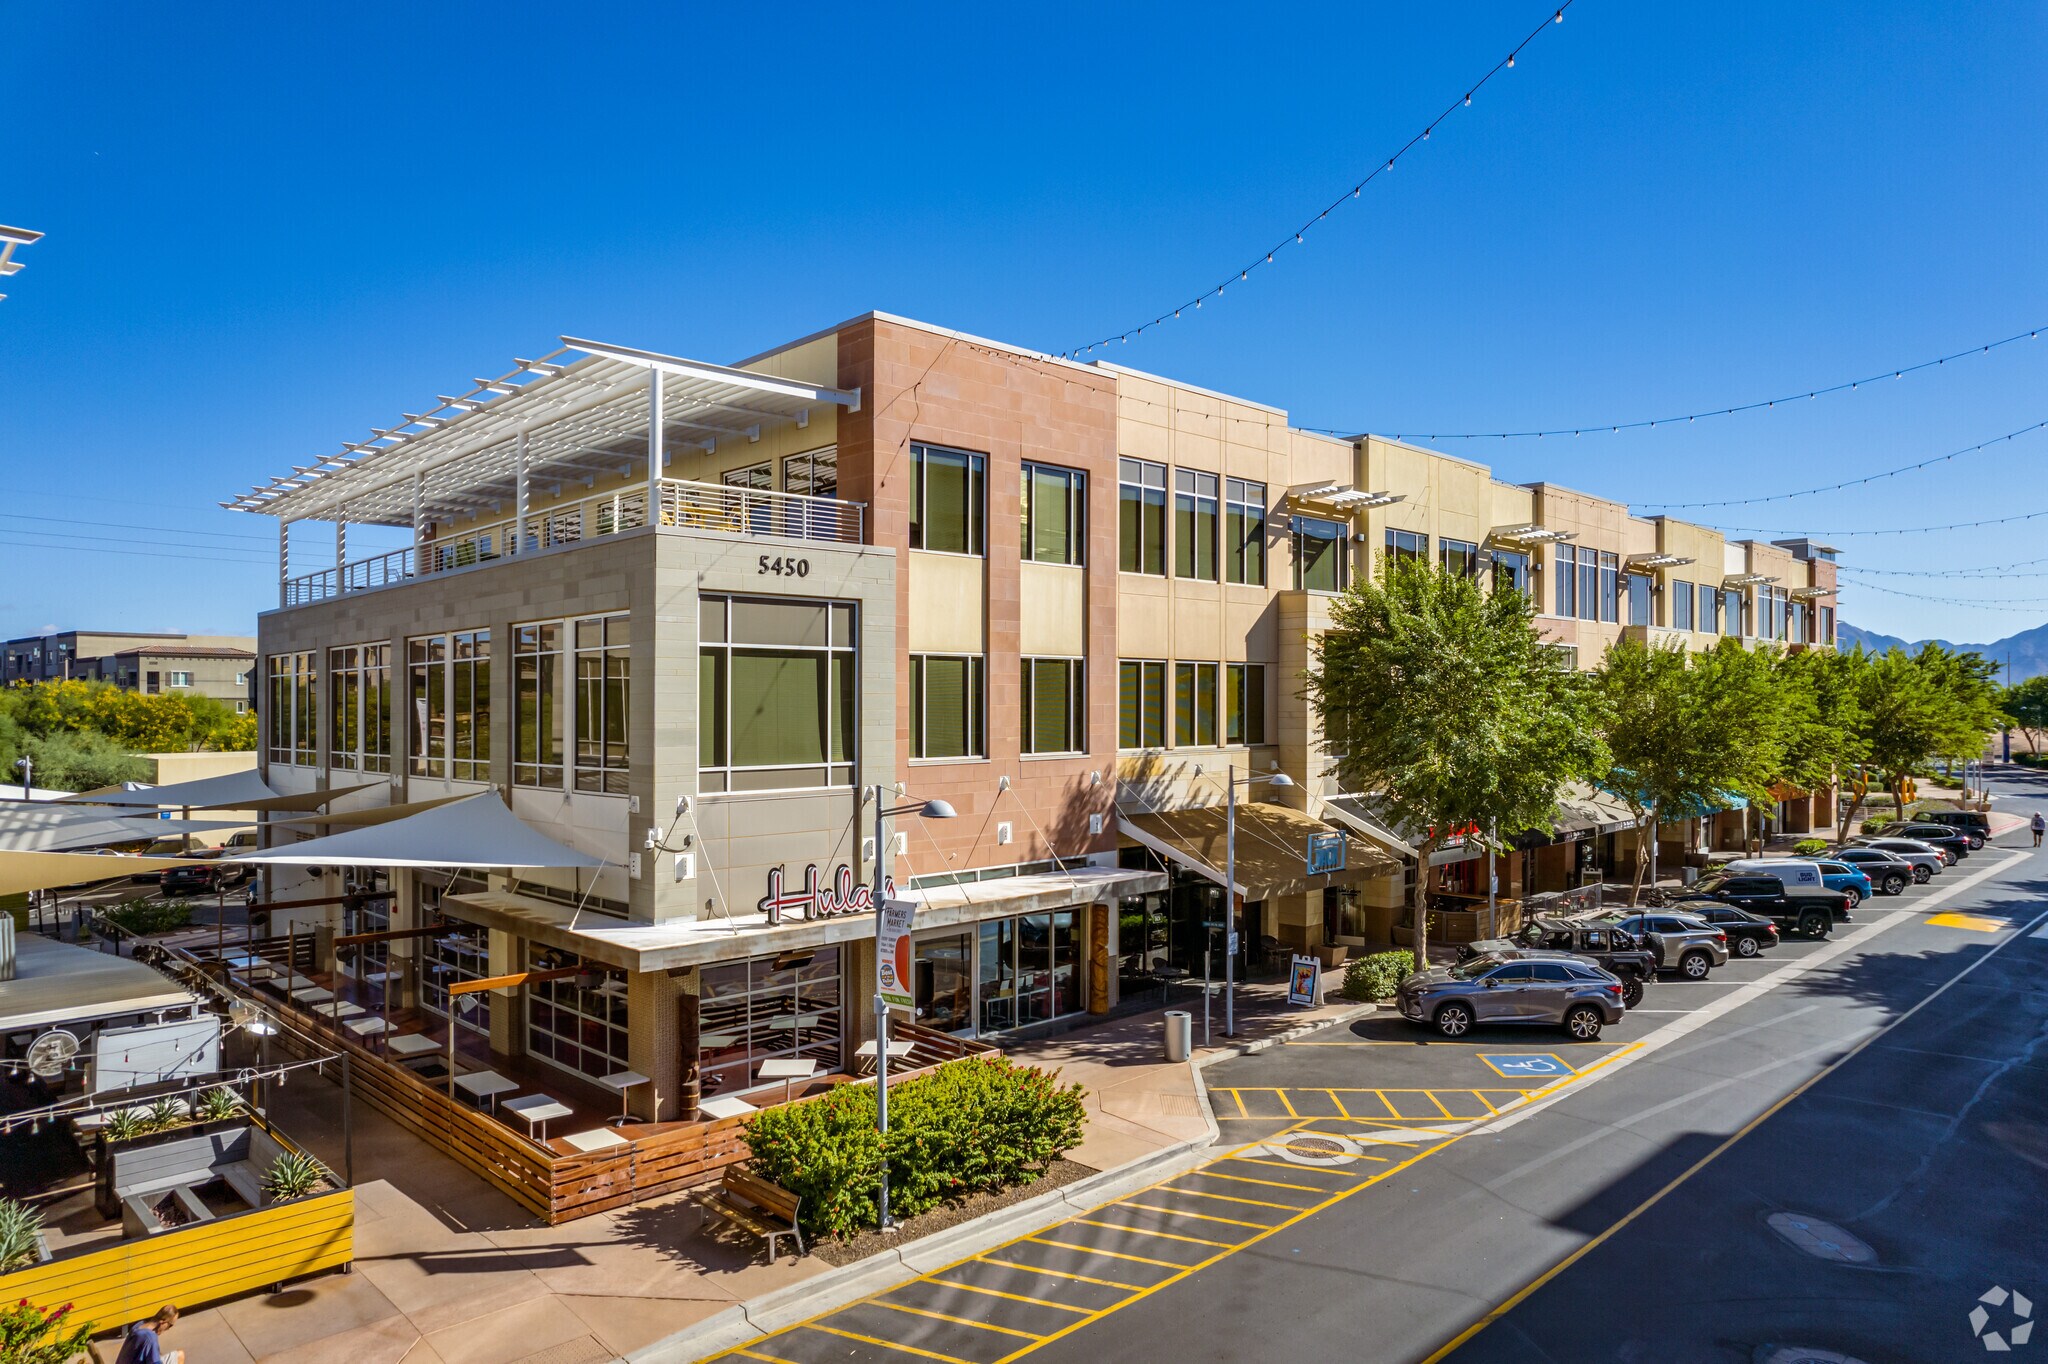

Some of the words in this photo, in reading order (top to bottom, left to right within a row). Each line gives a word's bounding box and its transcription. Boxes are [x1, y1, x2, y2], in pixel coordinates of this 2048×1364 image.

[758, 555, 809, 577] 5450
[757, 864, 896, 926] Hulas
[886, 907, 908, 919] FARMERS
[886, 918, 905, 928] MARKET
